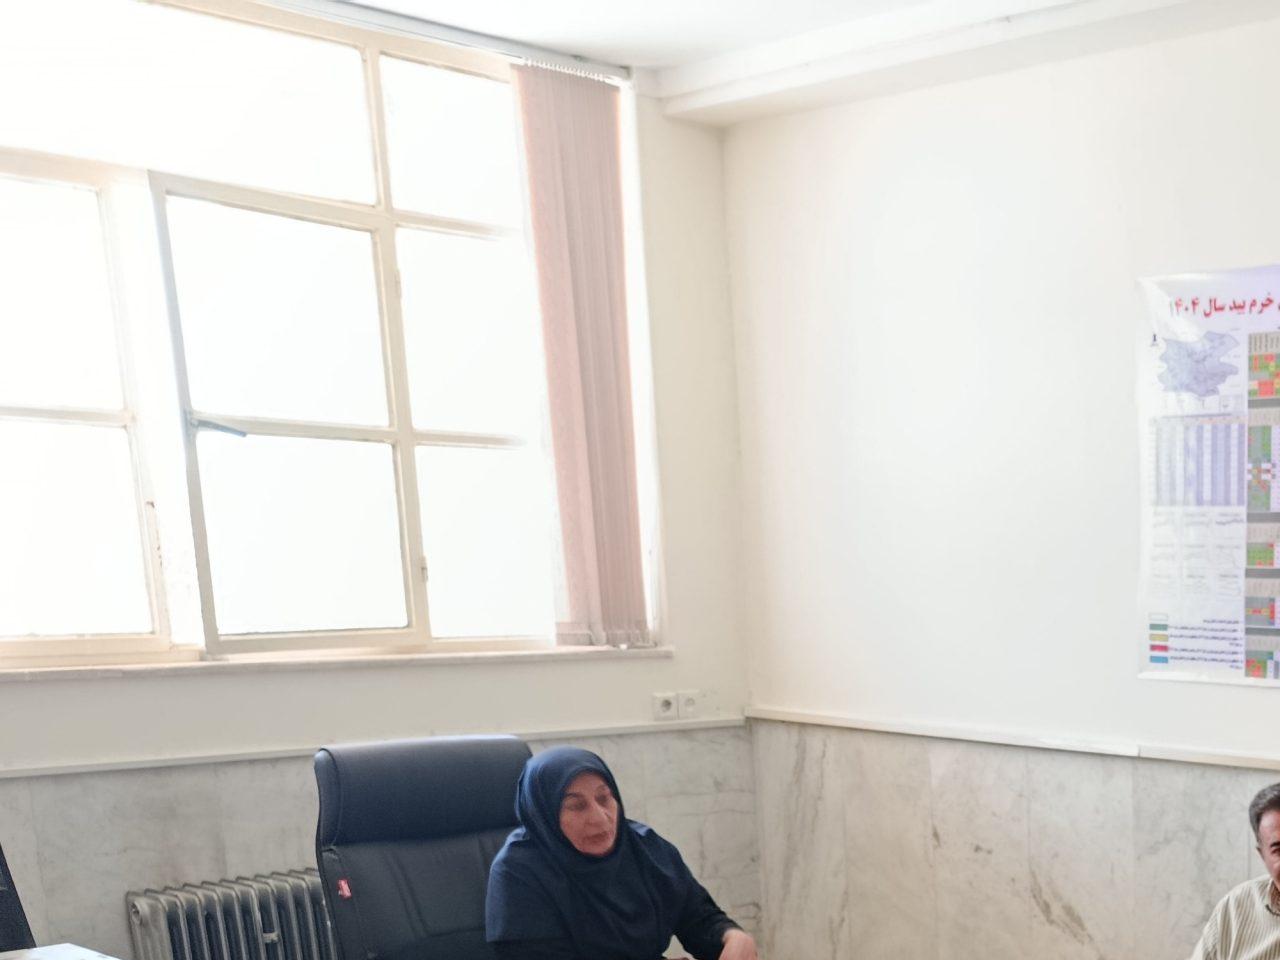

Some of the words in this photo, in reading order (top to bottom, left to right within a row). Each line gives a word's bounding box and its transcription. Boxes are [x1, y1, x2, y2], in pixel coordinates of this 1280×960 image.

[1203, 298, 1226, 317] سال
[1229, 300, 1246, 315] بید
[1249, 292, 1274, 315] خرم
